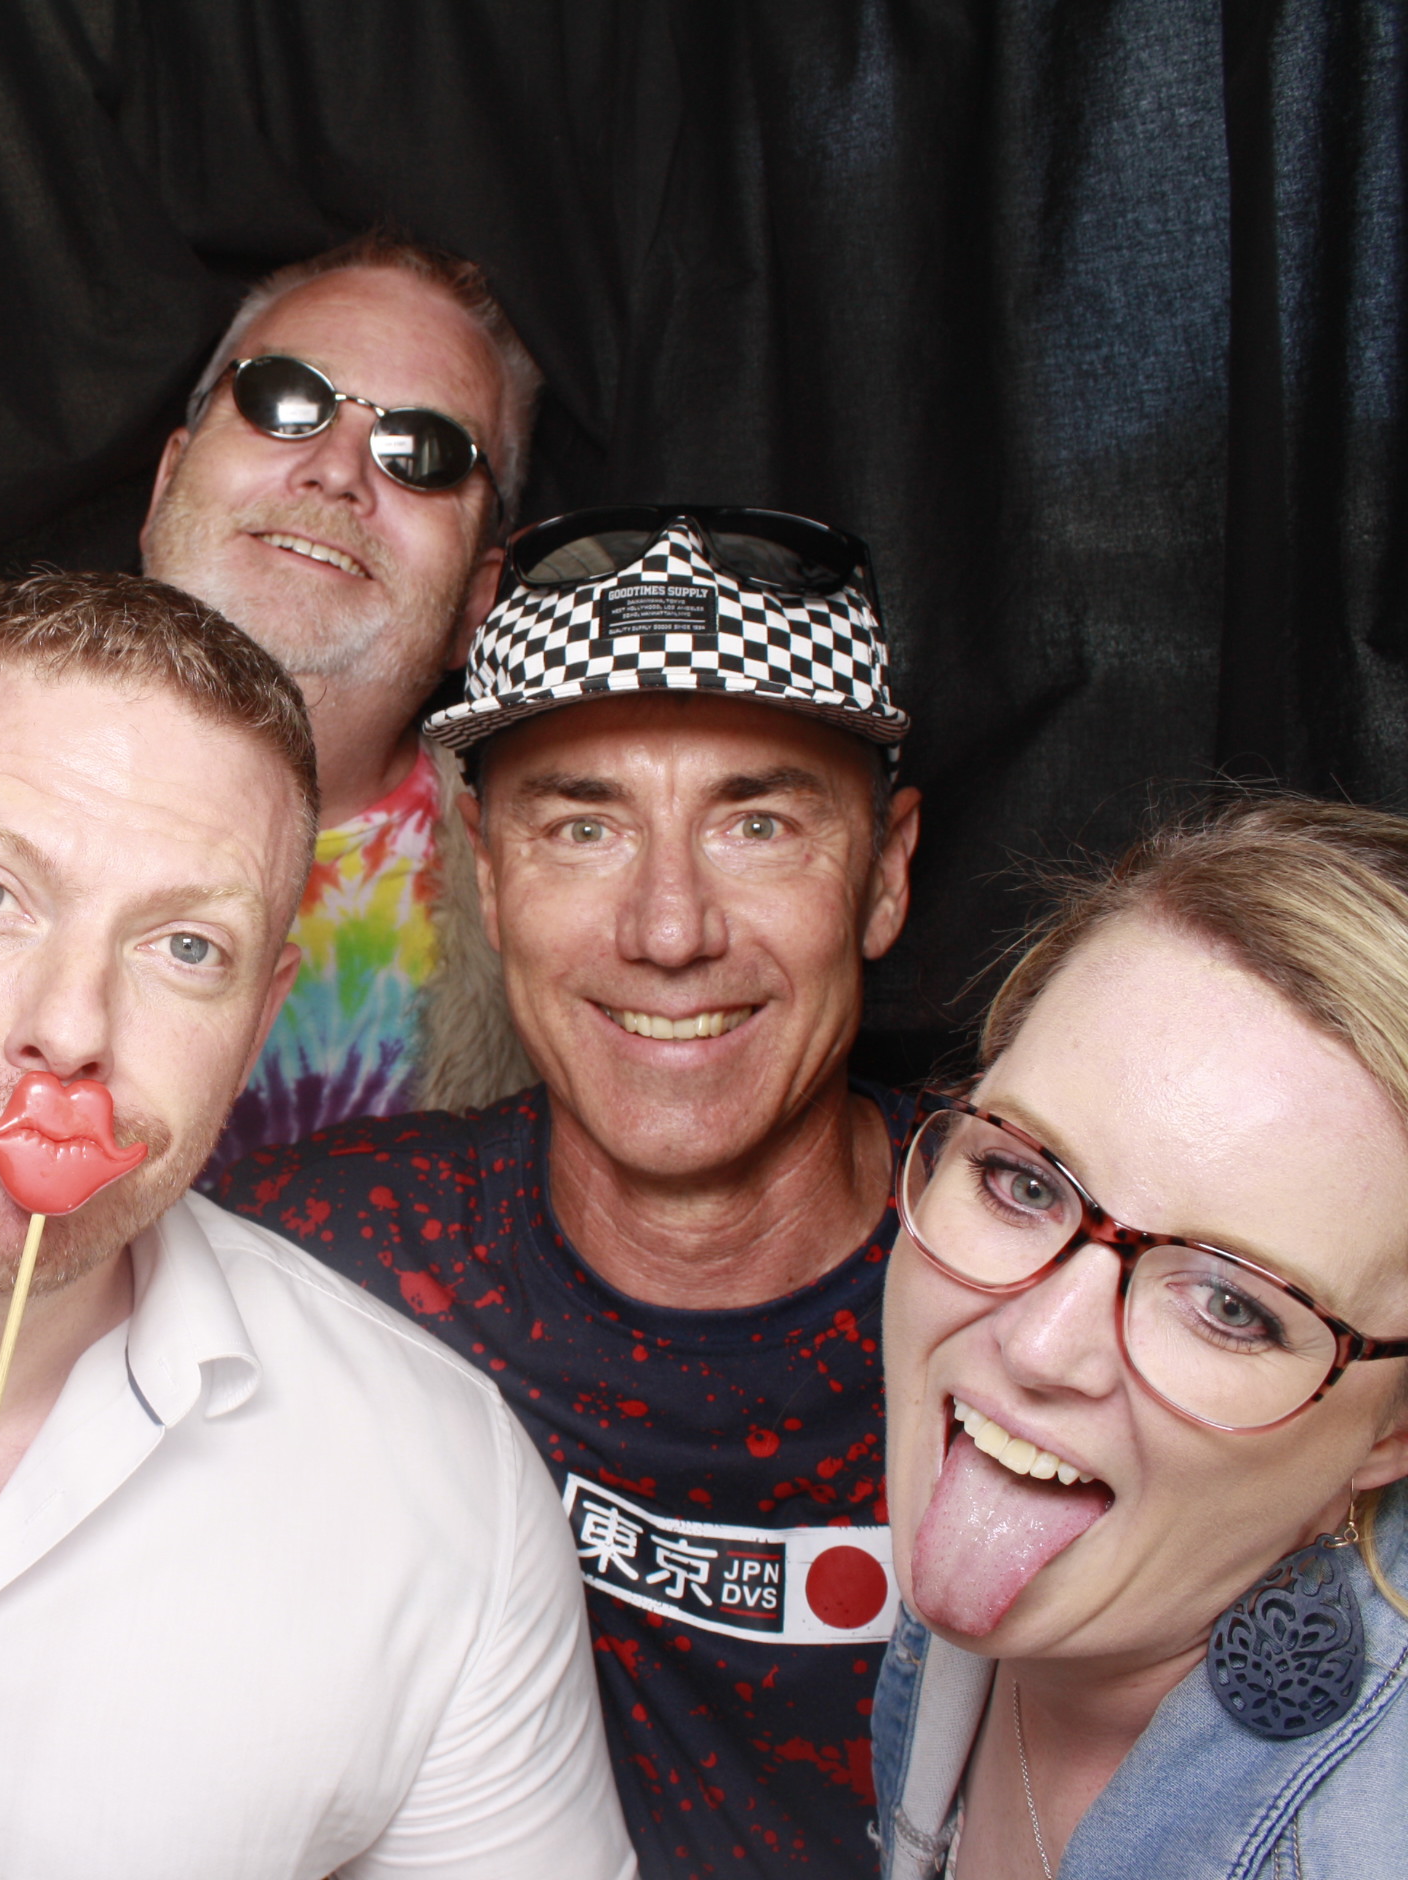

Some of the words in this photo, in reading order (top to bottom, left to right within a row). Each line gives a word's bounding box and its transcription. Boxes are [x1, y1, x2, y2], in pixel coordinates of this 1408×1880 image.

[608, 585, 666, 600] GOODTIMES
[667, 586, 708, 598] SUPPLY
[577, 1500, 719, 1606] 東京
[723, 1559, 779, 1584] JPN
[721, 1583, 777, 1609] DVS
